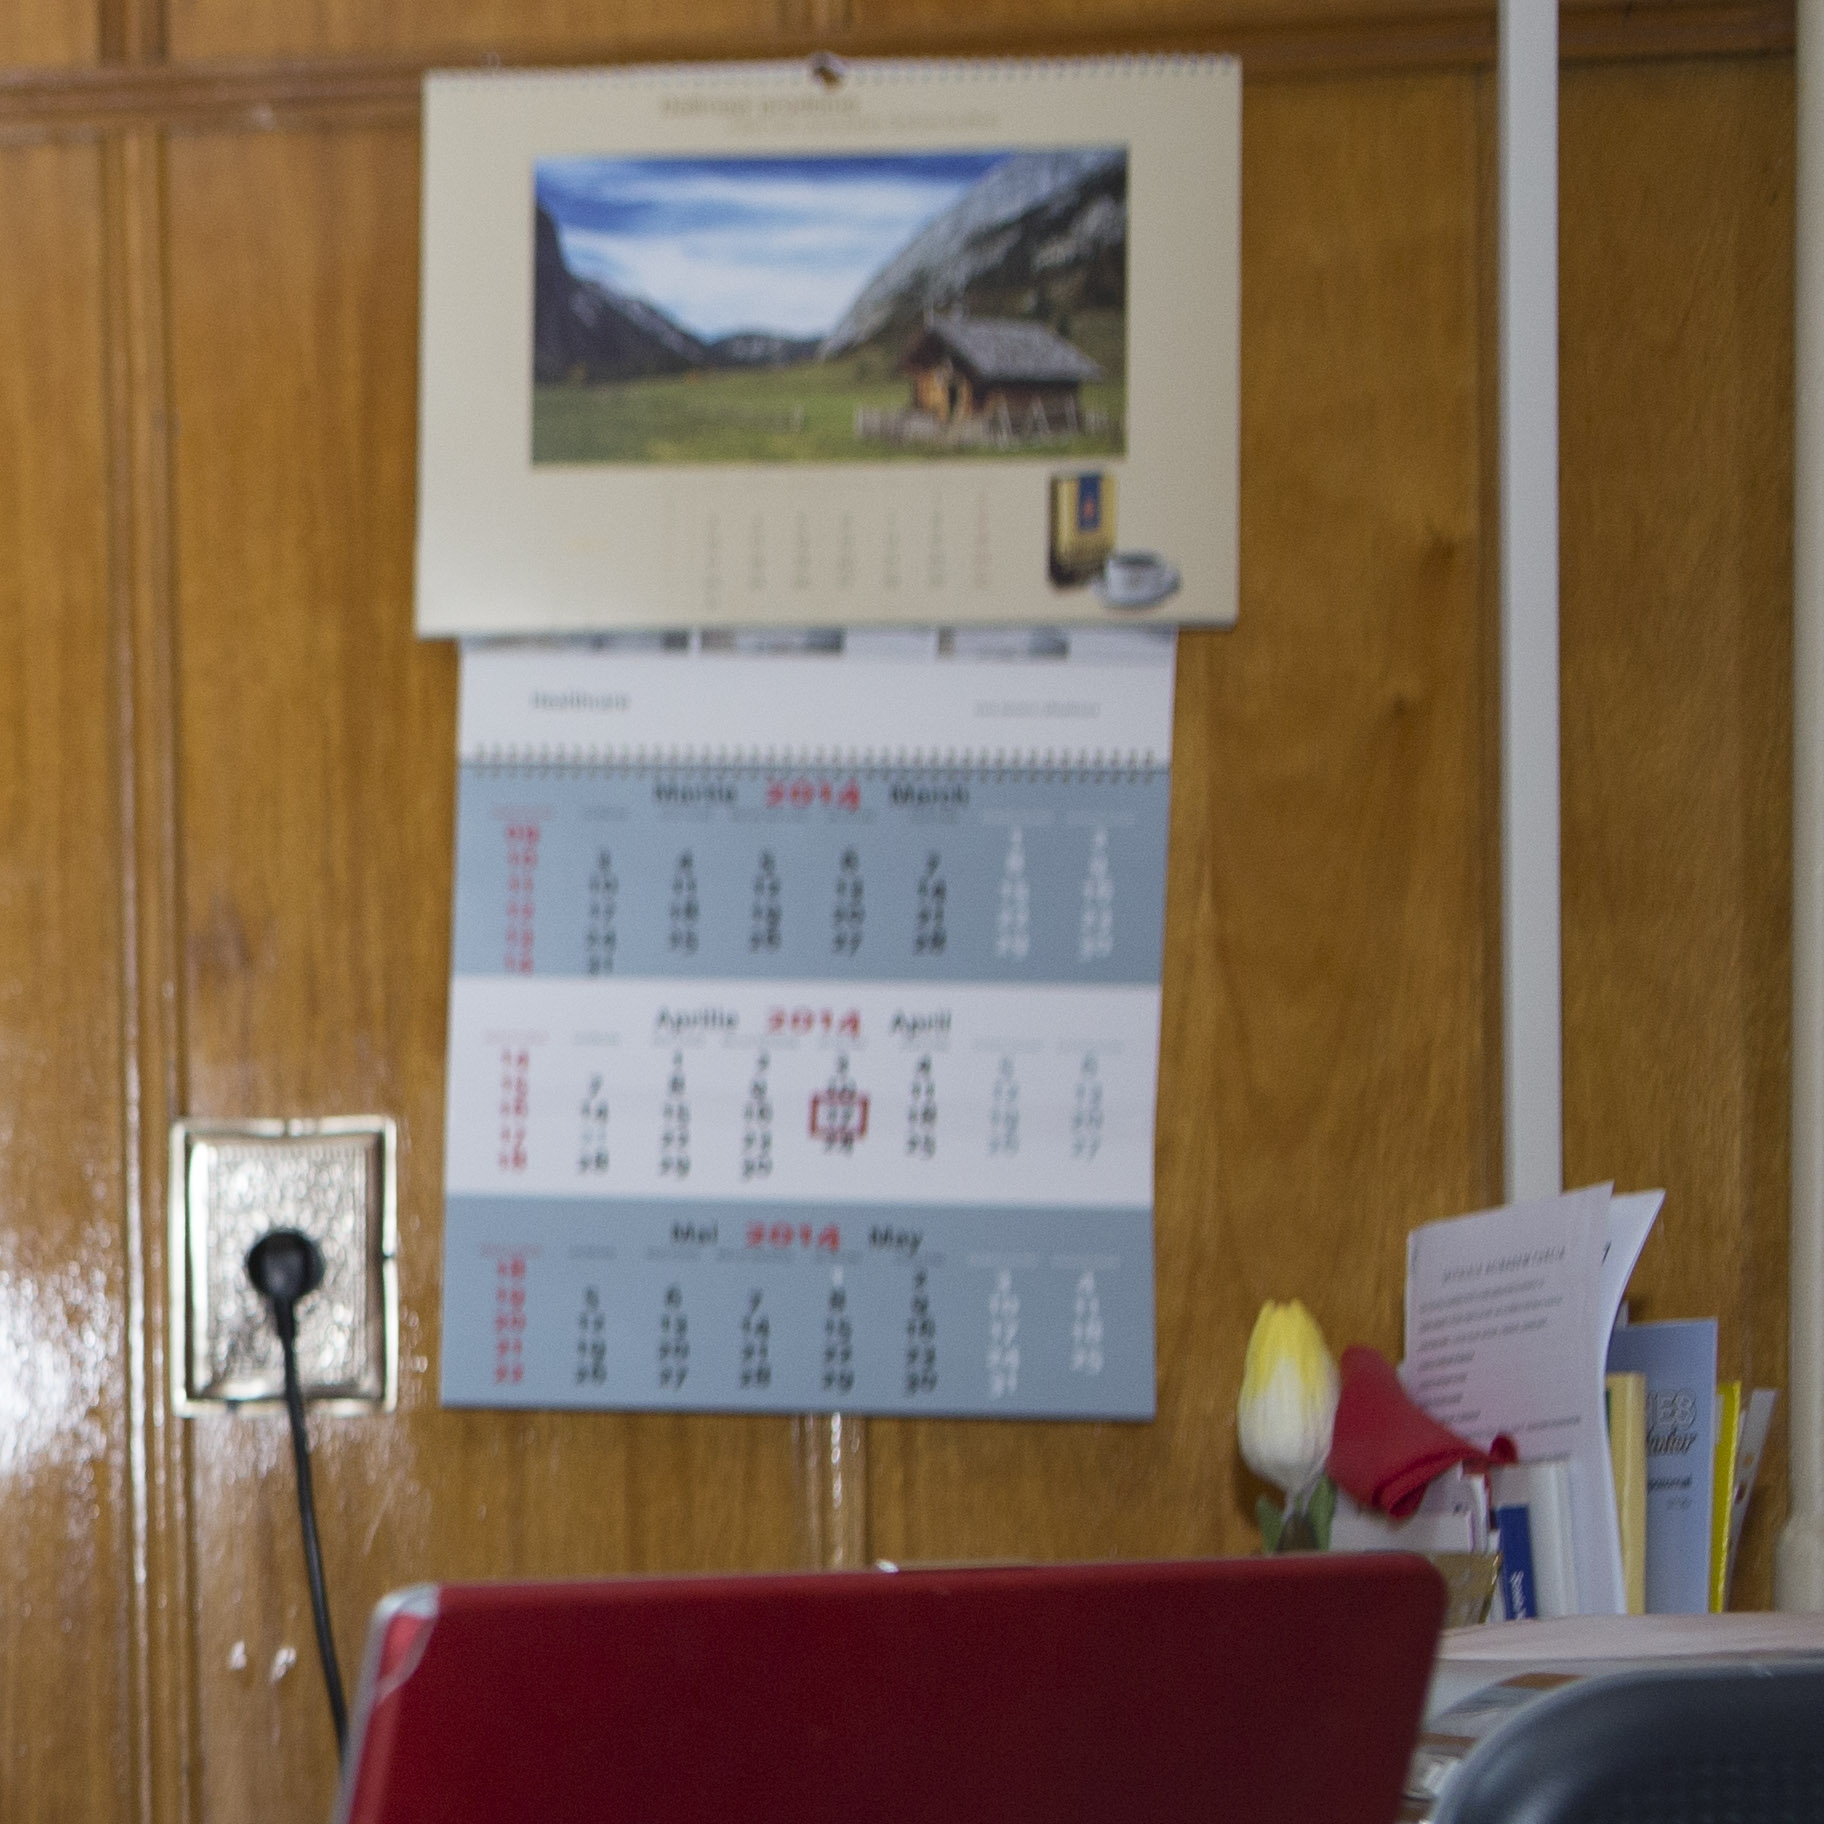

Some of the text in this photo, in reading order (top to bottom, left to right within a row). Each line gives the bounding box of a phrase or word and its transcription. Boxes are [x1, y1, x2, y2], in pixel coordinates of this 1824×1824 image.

[655, 781, 970, 811] Martie 2014 March
[656, 1007, 952, 1038] Aprilie 2014 April
[670, 1219, 719, 1244] Mai
[746, 1221, 840, 1251] 2014
[869, 1225, 923, 1258] May
